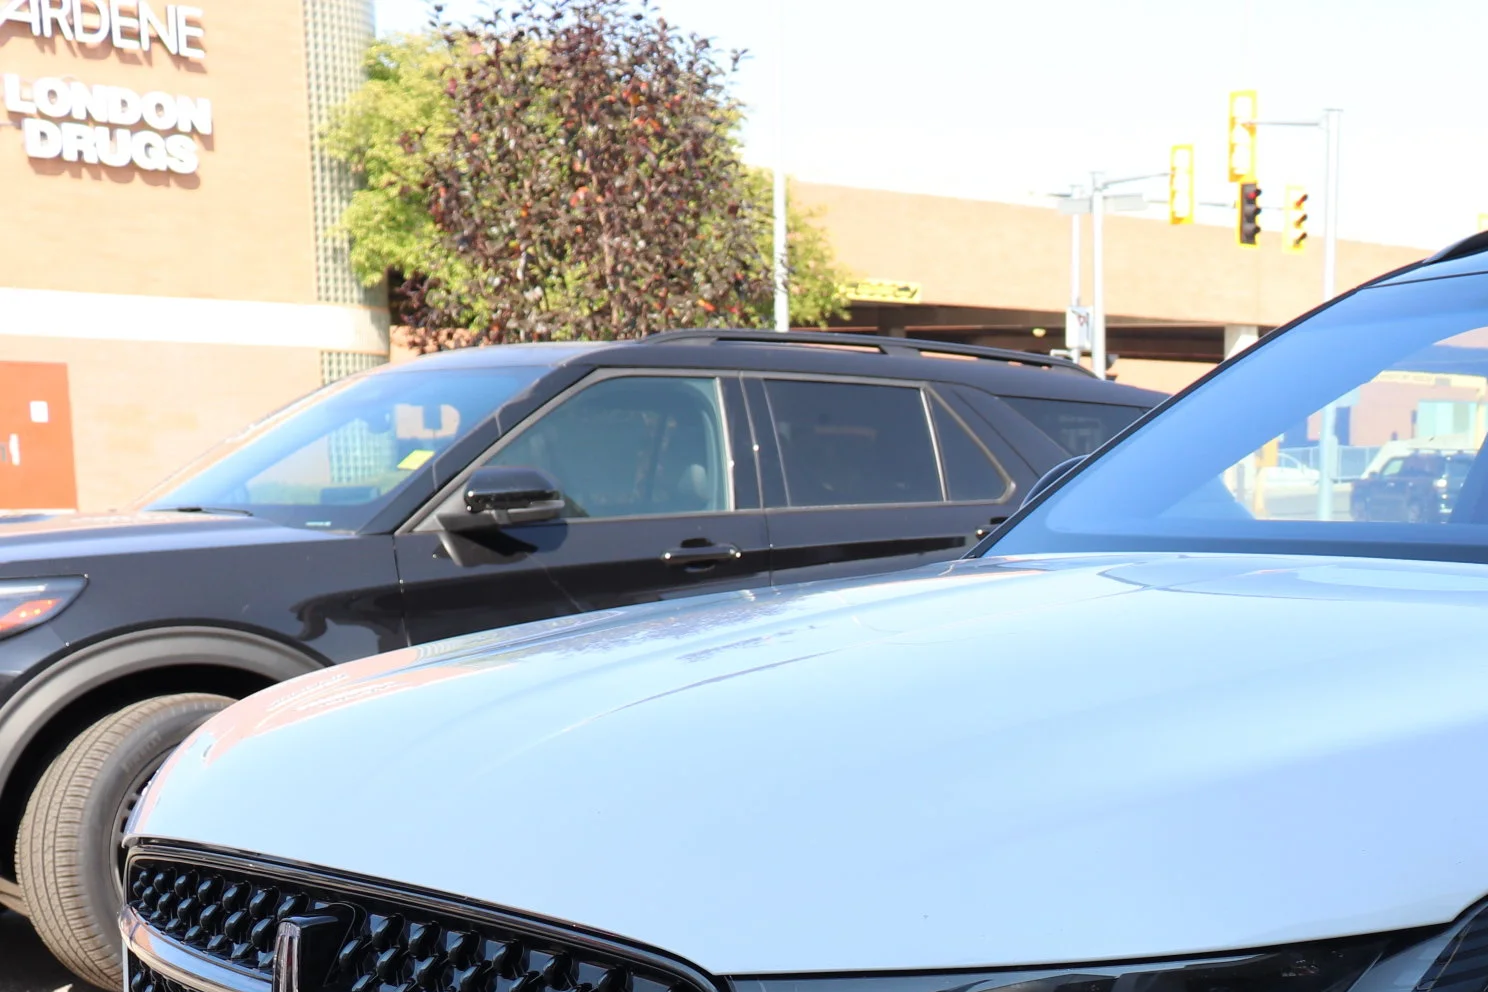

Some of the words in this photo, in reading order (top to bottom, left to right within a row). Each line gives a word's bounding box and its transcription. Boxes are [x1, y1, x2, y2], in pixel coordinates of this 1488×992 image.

[0, 0, 205, 59] ARDENE
[3, 73, 212, 135] LONDON
[23, 118, 199, 174] DRUGS
